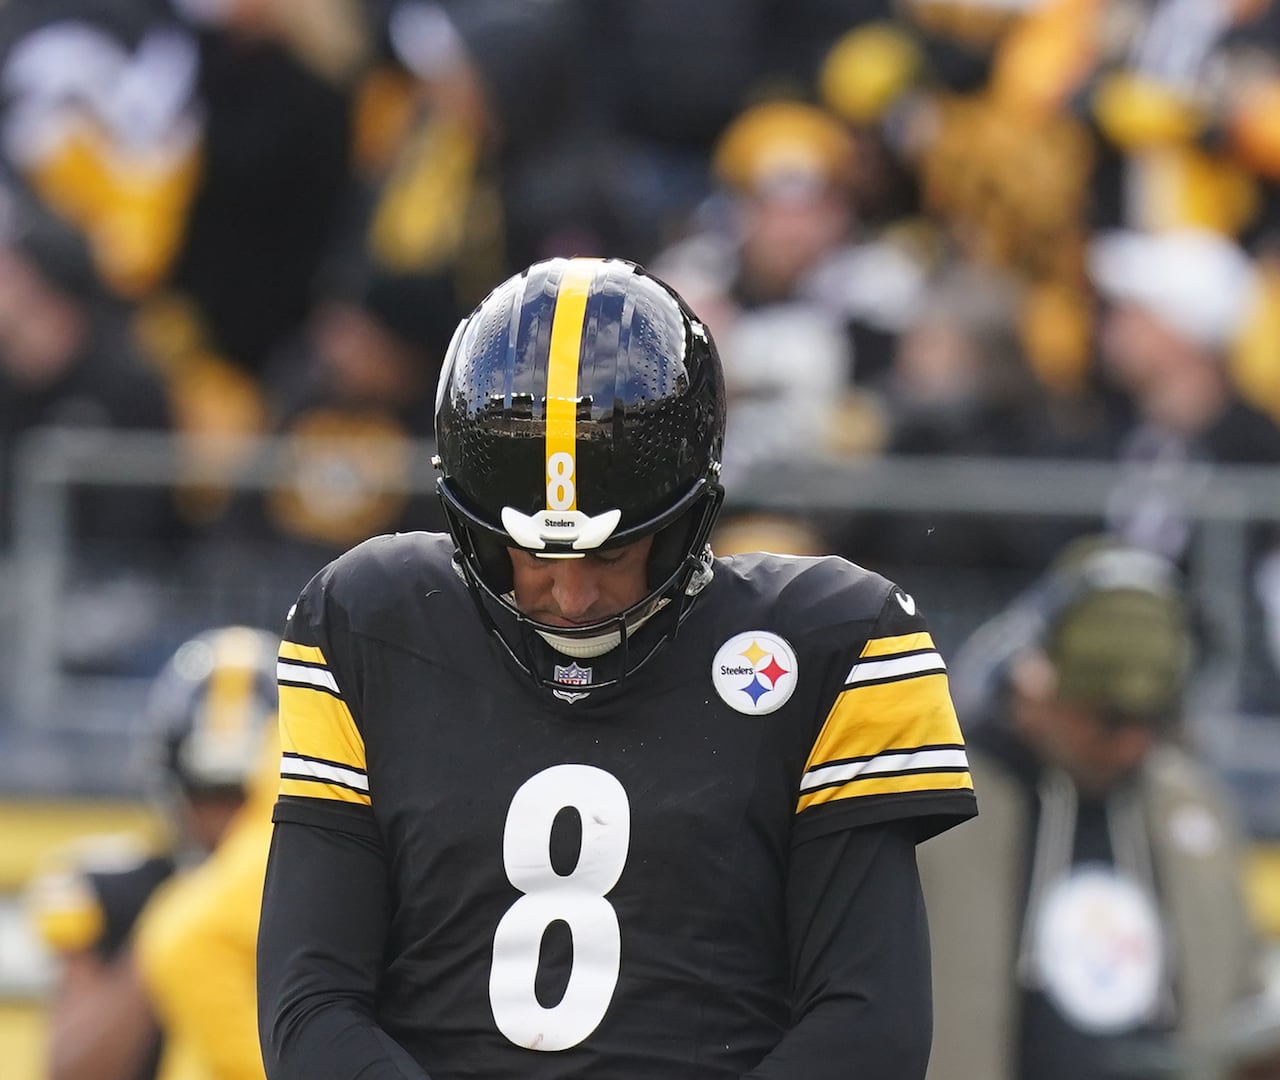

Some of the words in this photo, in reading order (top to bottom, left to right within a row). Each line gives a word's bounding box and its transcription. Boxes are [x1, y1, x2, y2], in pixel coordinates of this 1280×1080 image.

[547, 451, 575, 511] 8
[544, 518, 575, 528] Steelers
[720, 665, 754, 676] Steelers
[488, 763, 631, 1053] 8
